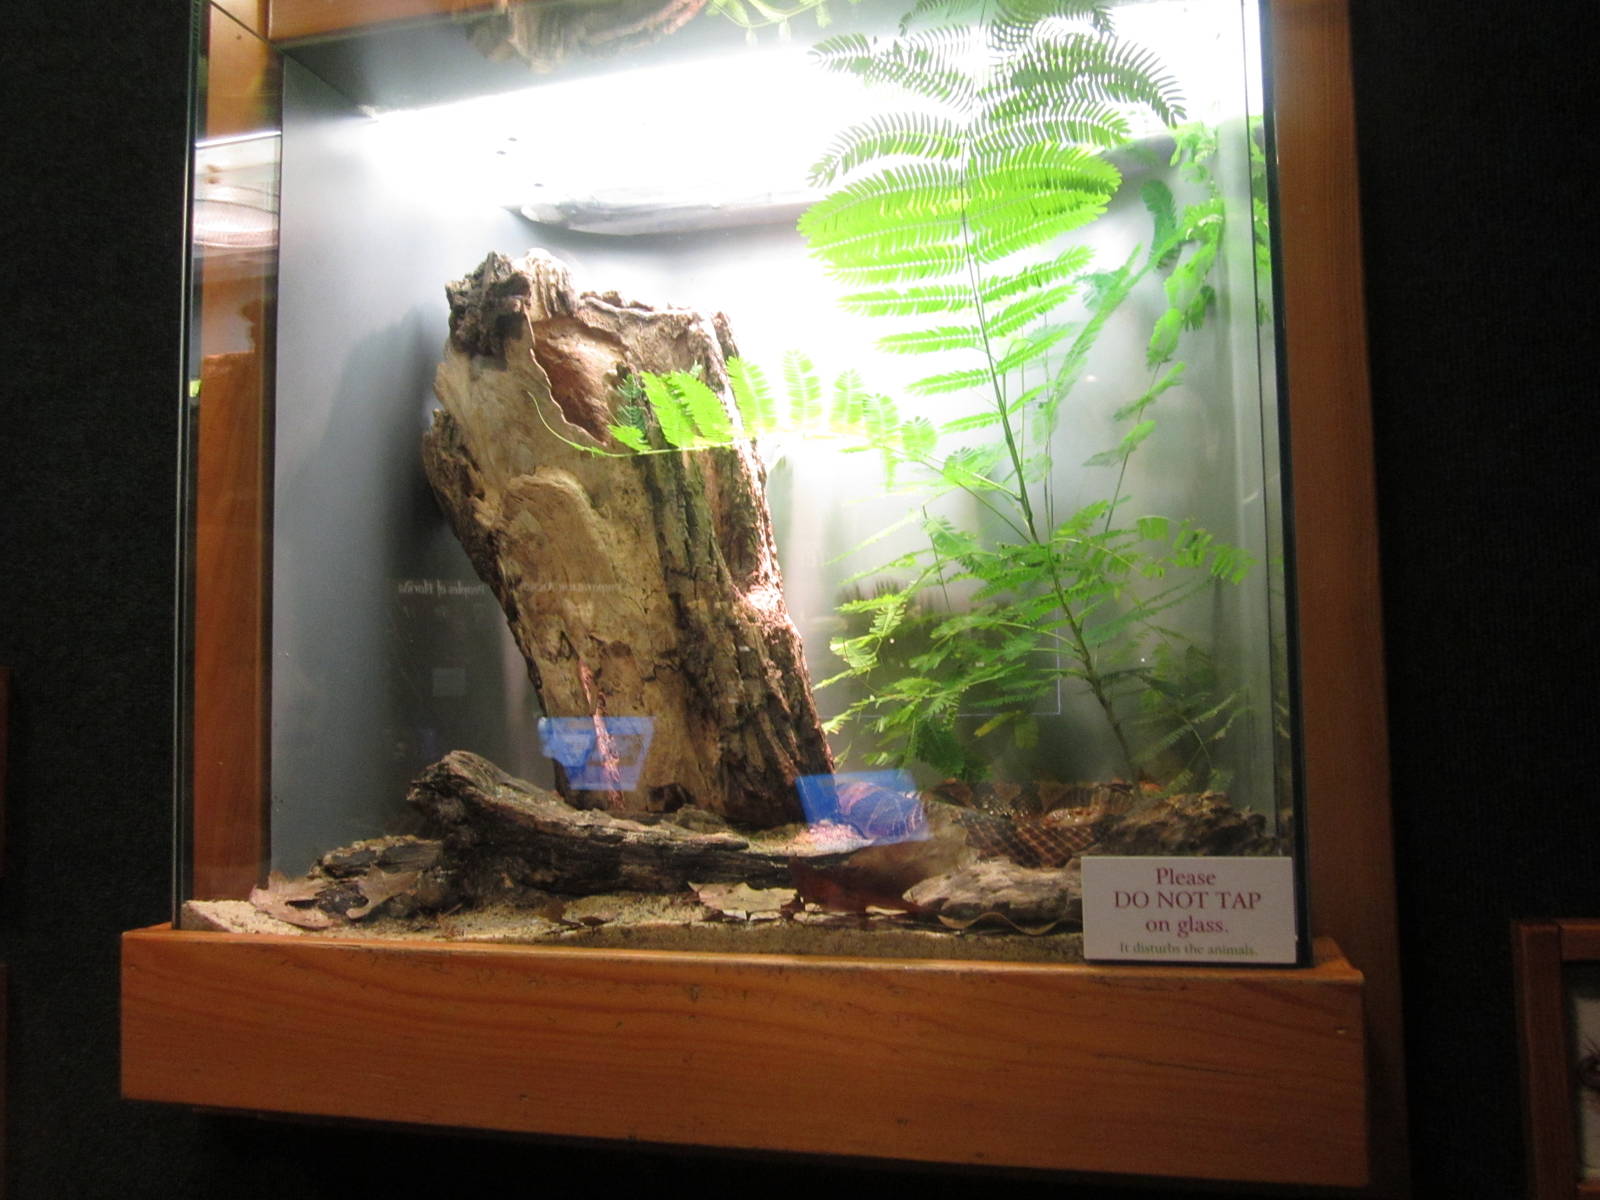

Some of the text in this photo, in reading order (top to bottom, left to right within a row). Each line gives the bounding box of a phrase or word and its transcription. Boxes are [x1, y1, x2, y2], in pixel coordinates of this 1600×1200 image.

[1155, 867, 1217, 886] Please
[1114, 890, 1262, 910] DO NOT TAP
[1145, 915, 1229, 938] on glass.
[1119, 942, 1258, 957] It disturbs the animals.
